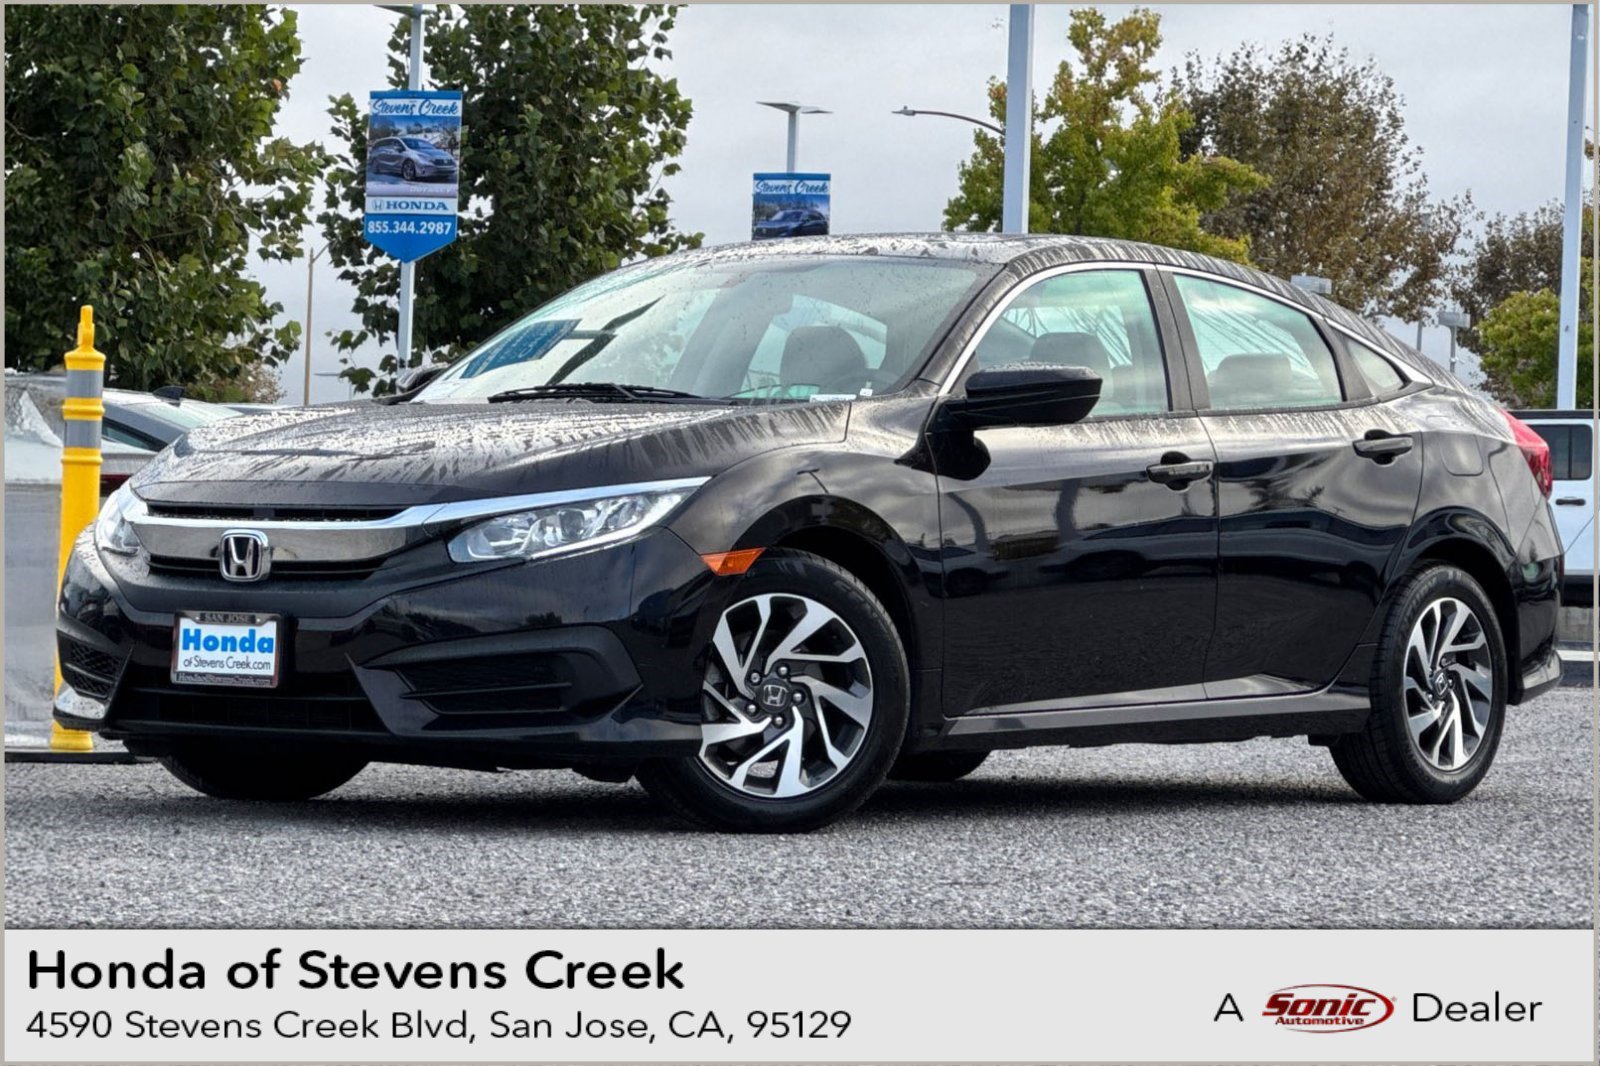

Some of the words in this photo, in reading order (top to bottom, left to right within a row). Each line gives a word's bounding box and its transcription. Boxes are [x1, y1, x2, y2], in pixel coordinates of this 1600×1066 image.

[372, 98, 416, 116] Stevens
[418, 98, 459, 116] Creek
[755, 178, 792, 194] Stevens
[794, 178, 828, 194] Creek
[386, 200, 449, 211] HONDA
[367, 220, 452, 236] 855.344.2987
[205, 613, 224, 622] SAN
[227, 614, 251, 624] JOSE
[182, 628, 274, 653] Honda
